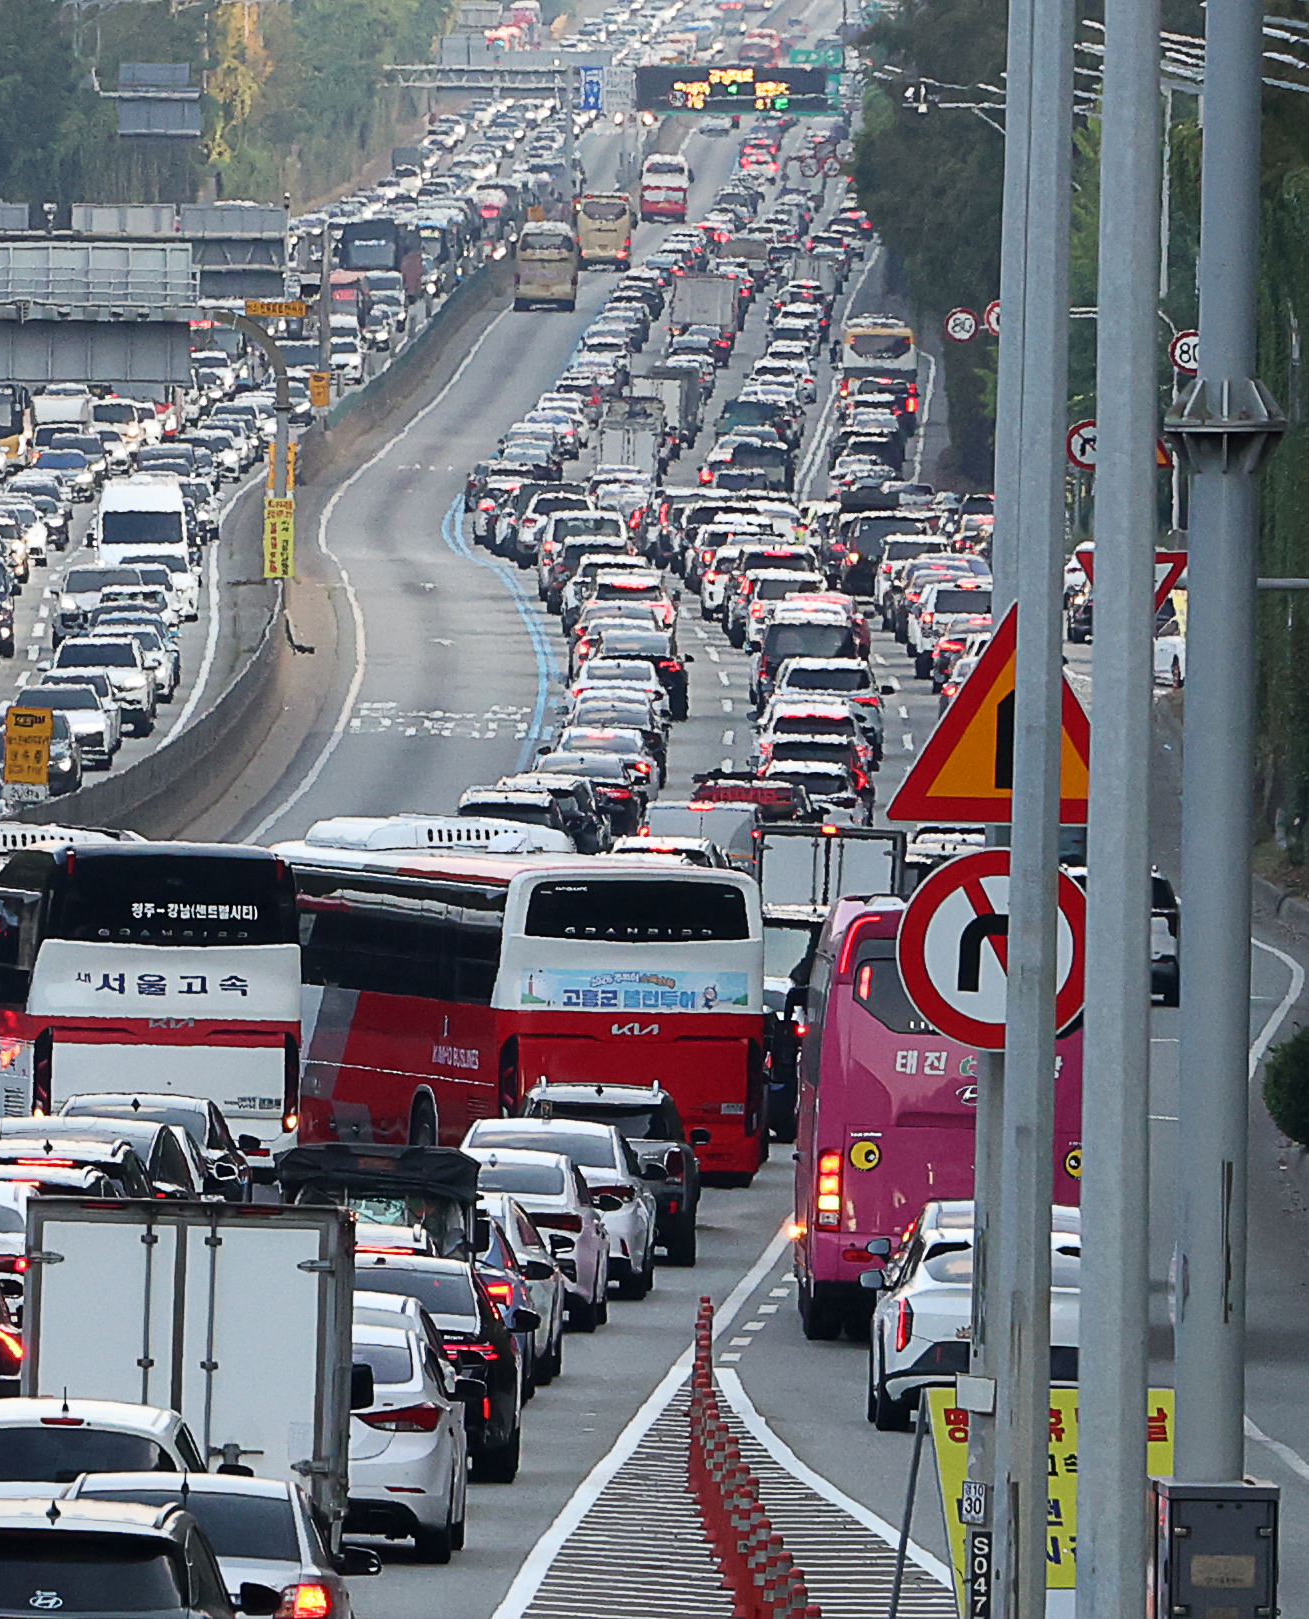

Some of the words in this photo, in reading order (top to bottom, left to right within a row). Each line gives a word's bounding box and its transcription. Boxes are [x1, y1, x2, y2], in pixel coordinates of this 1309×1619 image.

[951, 317, 973, 334] 80
[611, 1022, 660, 1035] KIA
[964, 1497, 982, 1515] 30
[973, 1537, 989, 1619] S047
